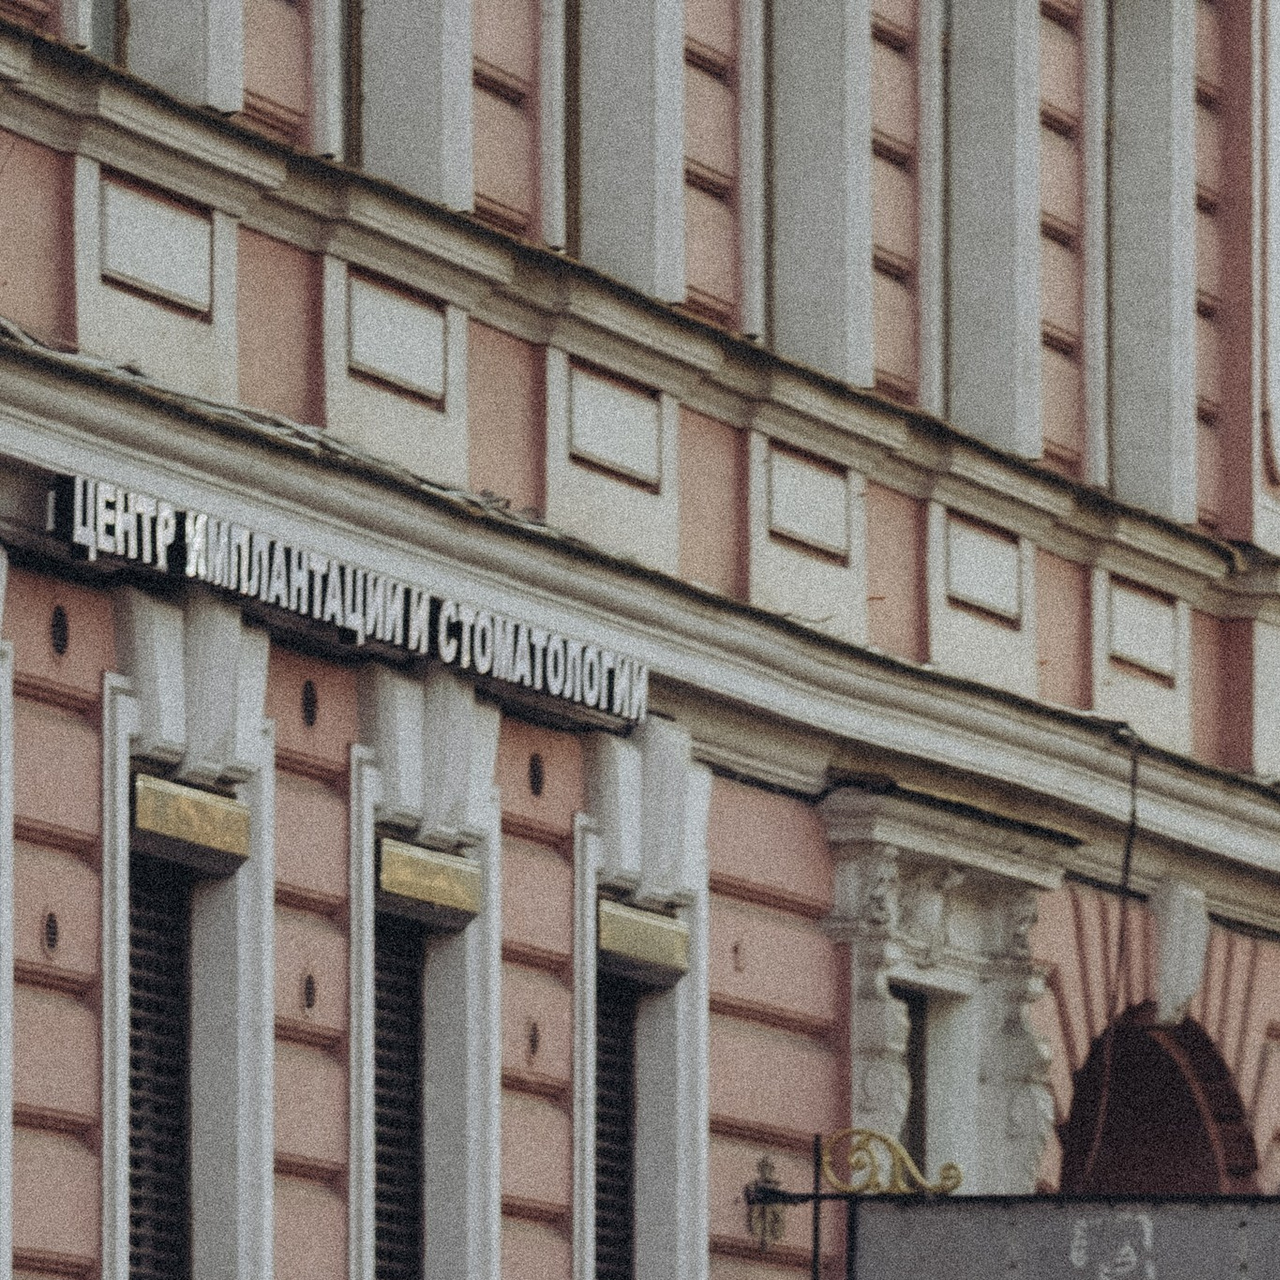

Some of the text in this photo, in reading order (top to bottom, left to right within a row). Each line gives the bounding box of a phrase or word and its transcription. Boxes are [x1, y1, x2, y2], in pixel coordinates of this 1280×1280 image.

[72, 474, 649, 721] ЦЕНТР ИМПЛАНТАЦИИ И СТОМАТОЛОГИИ
